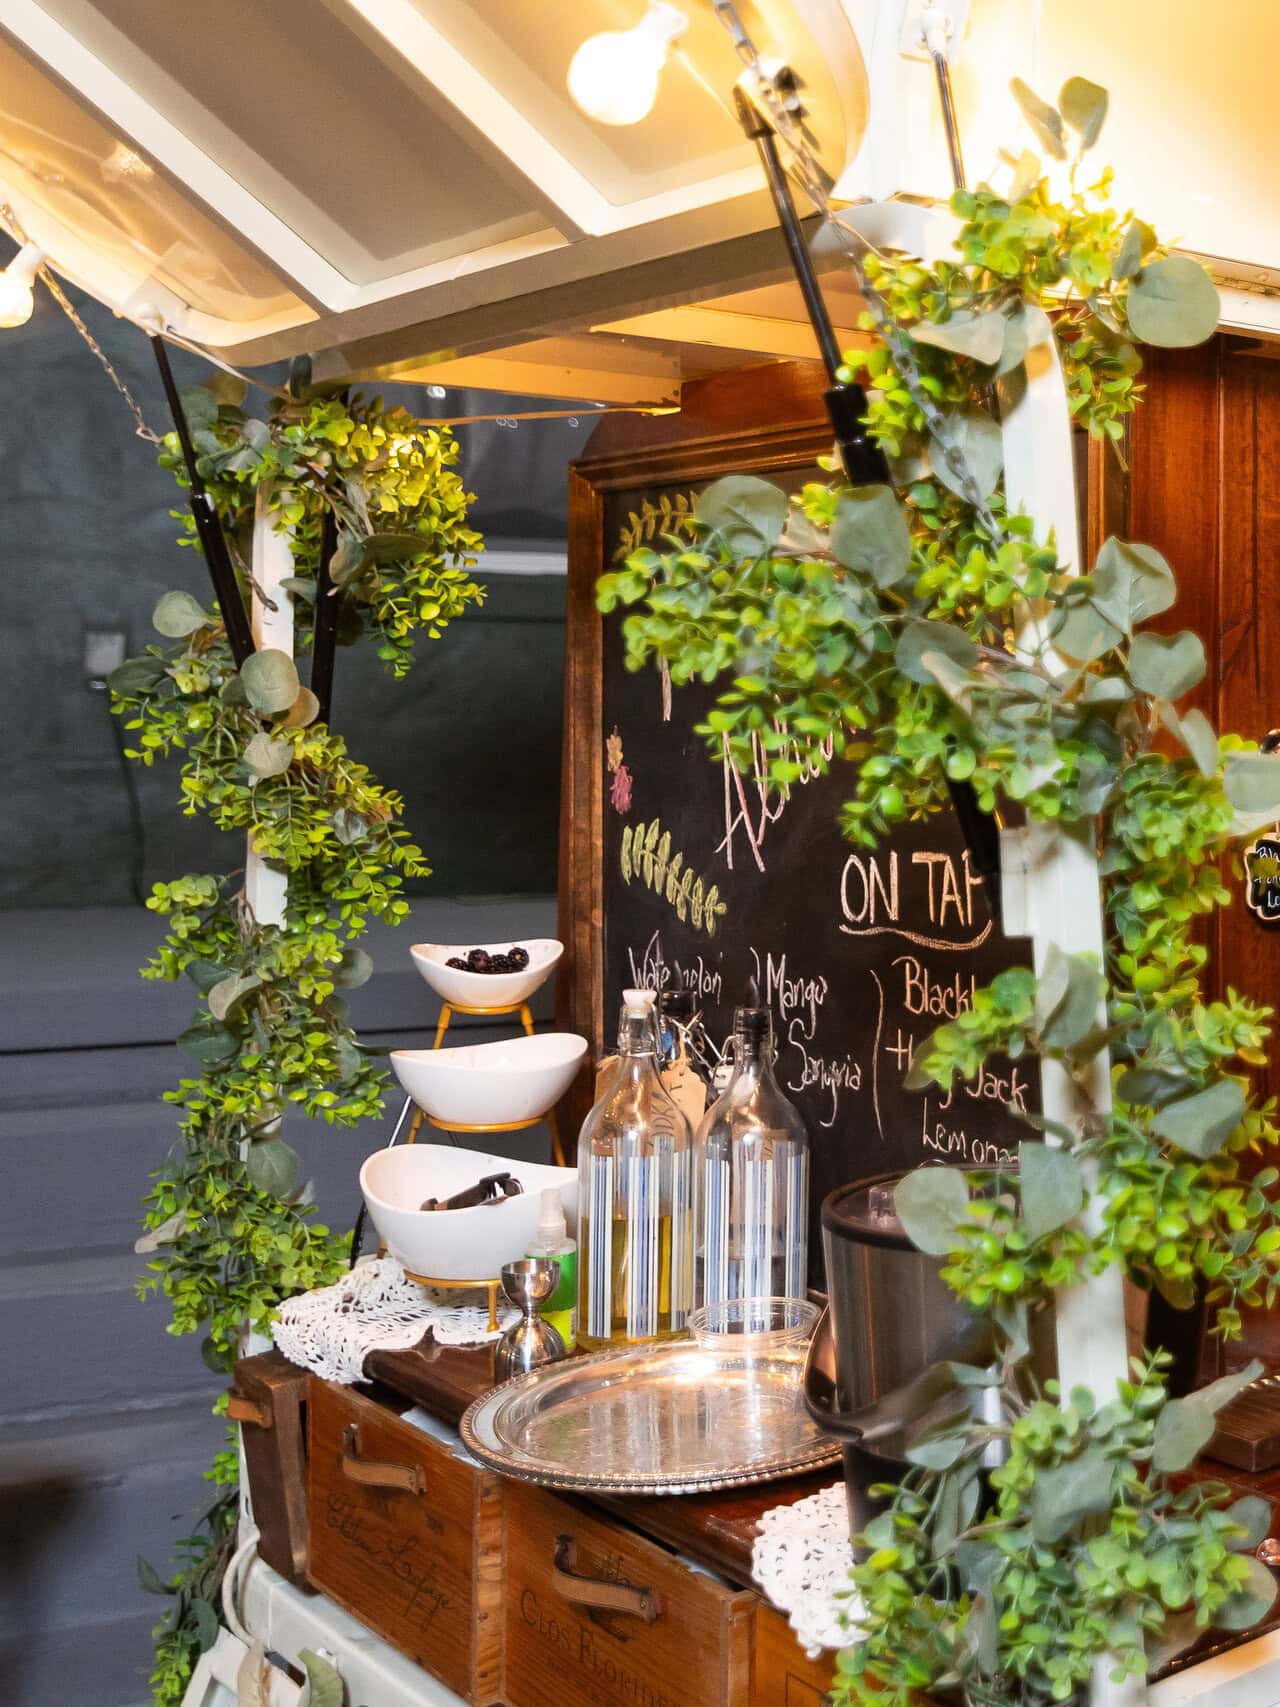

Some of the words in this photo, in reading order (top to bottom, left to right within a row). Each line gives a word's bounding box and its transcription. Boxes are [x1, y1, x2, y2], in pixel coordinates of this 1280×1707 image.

[840, 850, 899, 924] ON
[627, 929, 722, 1005] Wateelon
[766, 951, 829, 1041] Mango
[966, 1060, 1029, 1115] Jack
